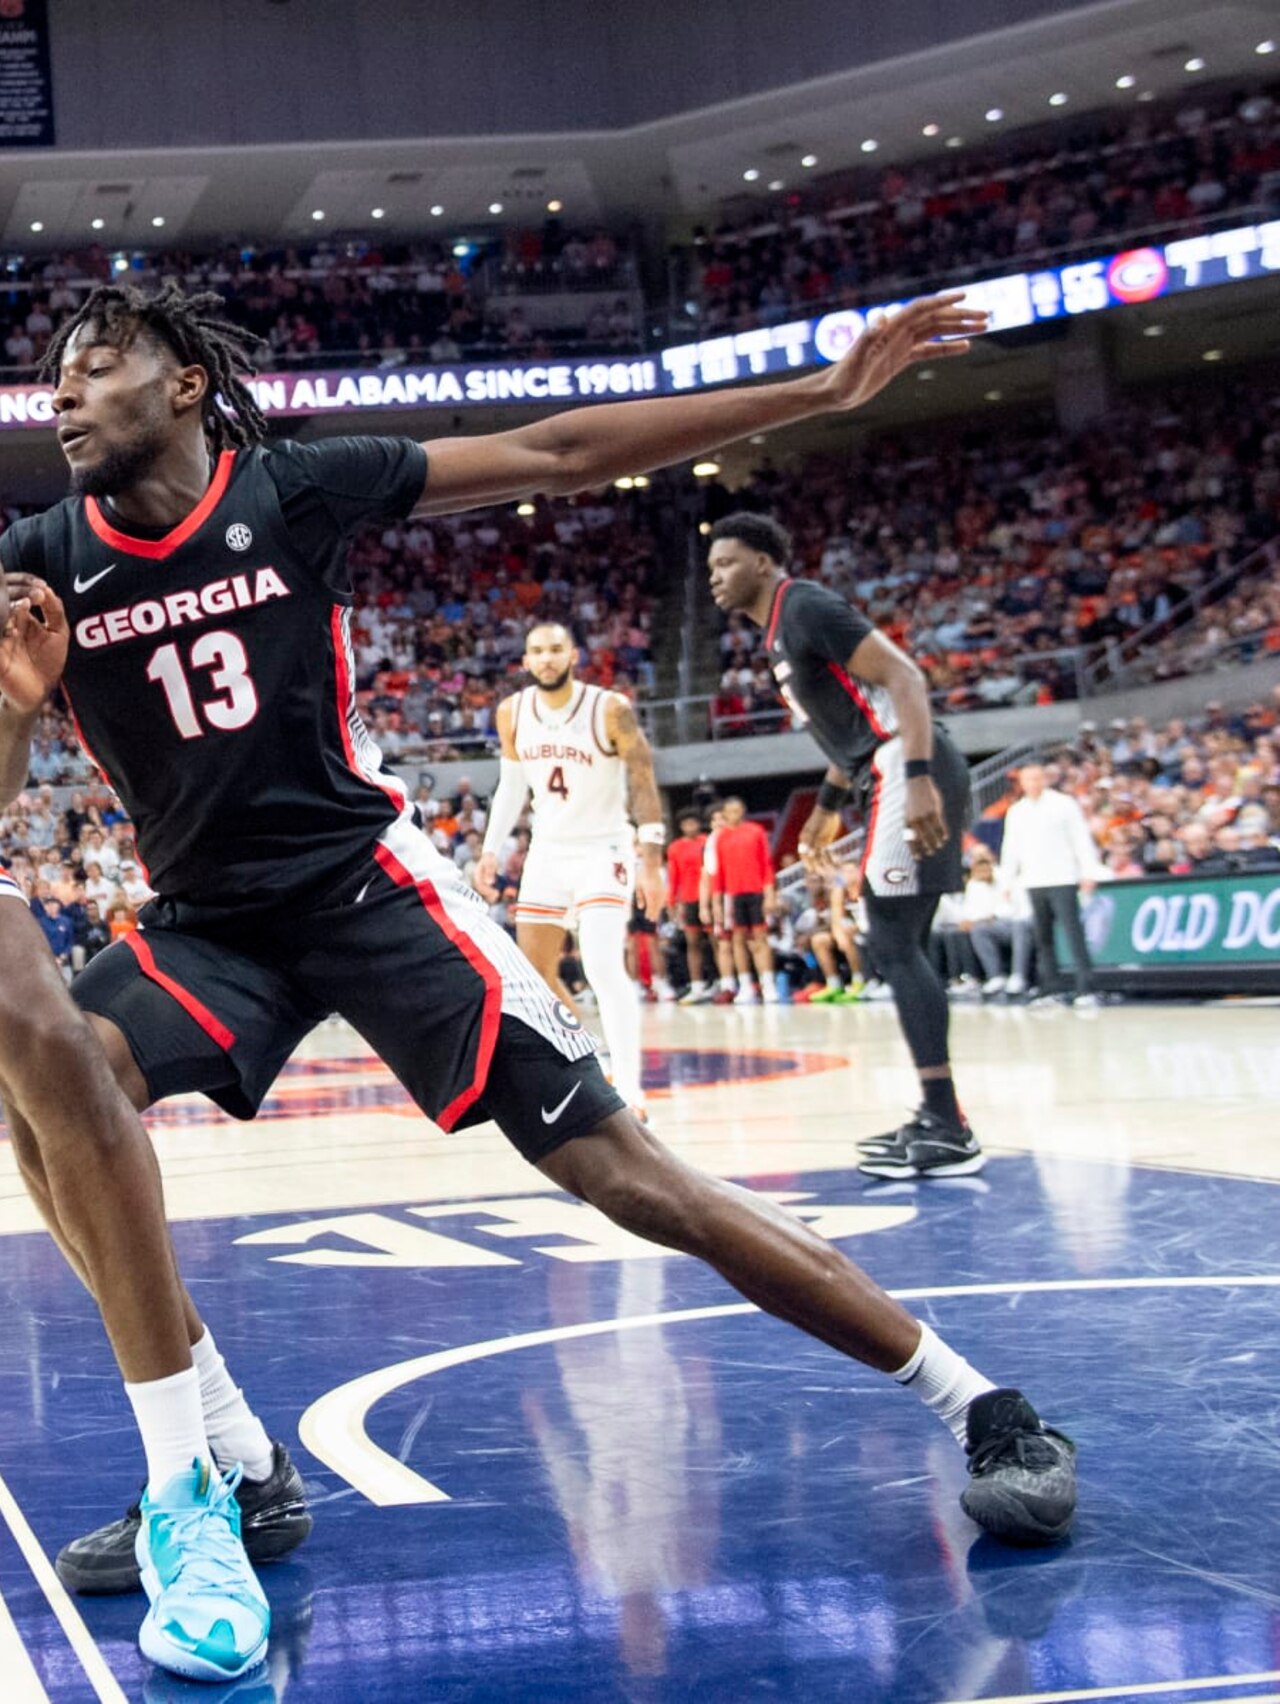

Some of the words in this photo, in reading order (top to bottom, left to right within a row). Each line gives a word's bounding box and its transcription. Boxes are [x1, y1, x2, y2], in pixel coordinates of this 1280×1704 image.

[290, 370, 463, 408] ALABAMA
[466, 364, 574, 401] SINCE
[574, 361, 656, 394] 1981!
[227, 525, 251, 549] SEC
[75, 565, 291, 648] GEORGIA
[145, 630, 259, 739] 13
[547, 766, 569, 801] 4
[1131, 894, 1218, 953] OLD
